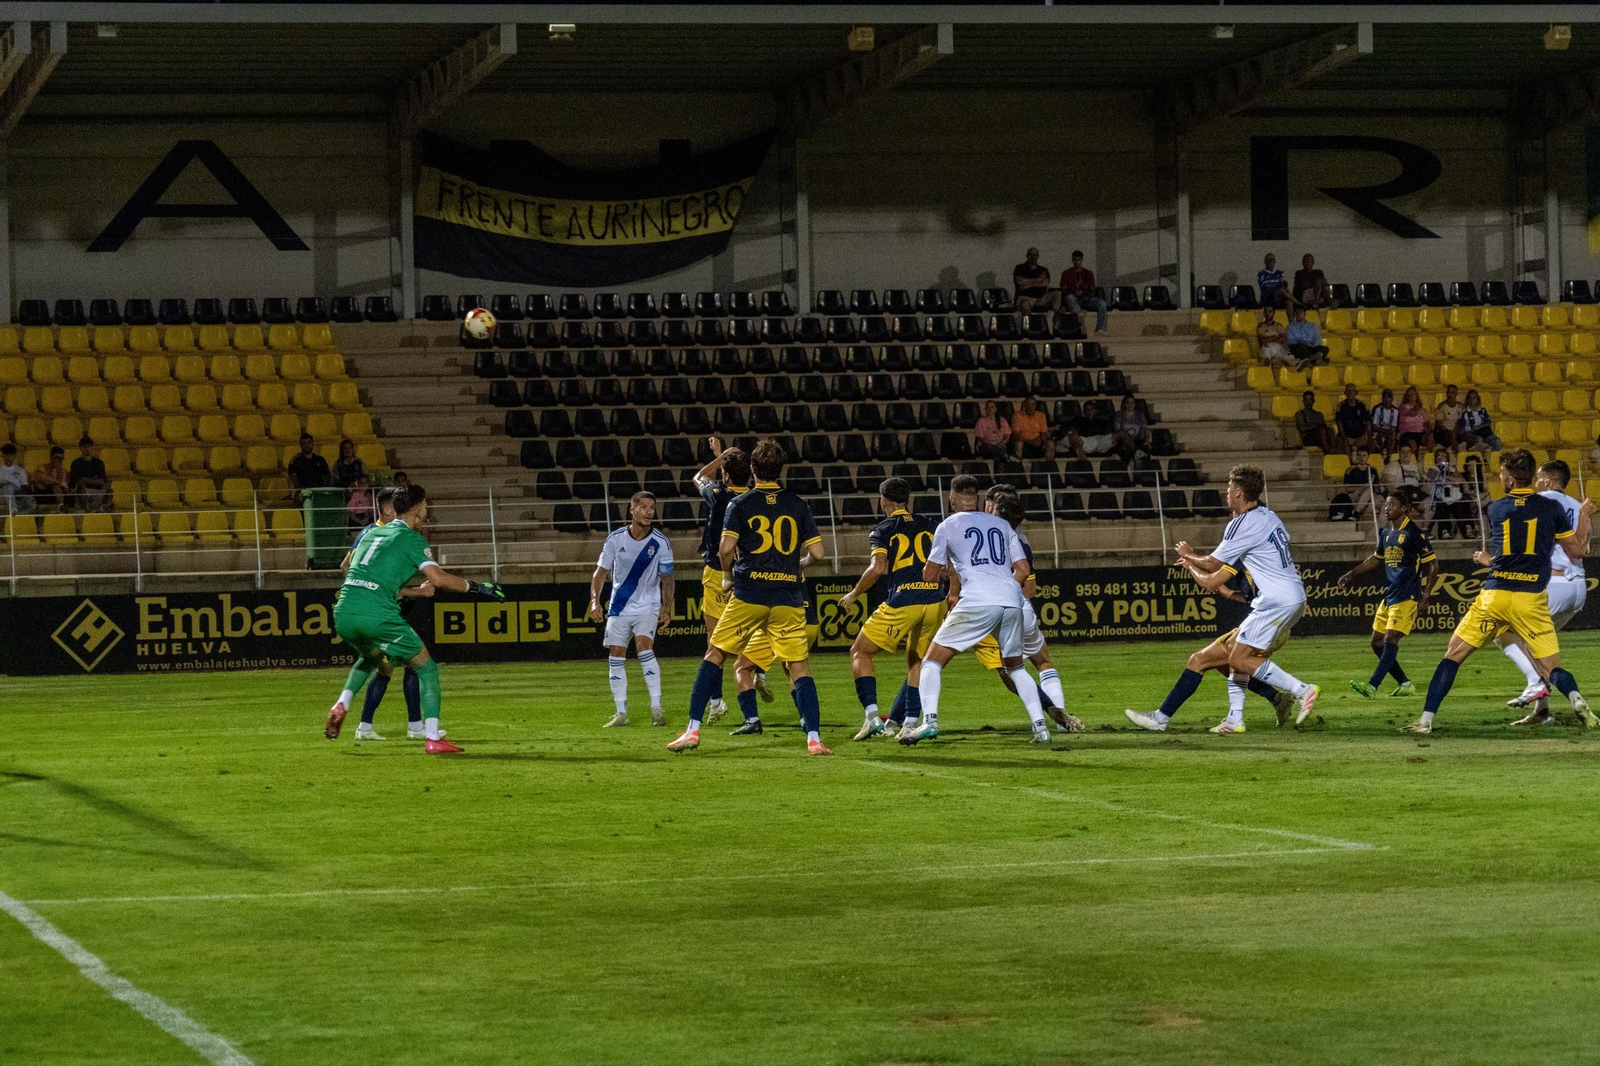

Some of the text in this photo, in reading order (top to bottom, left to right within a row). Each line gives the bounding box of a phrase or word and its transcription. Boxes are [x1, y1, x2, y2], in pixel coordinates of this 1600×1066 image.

[85, 139, 311, 252] A
[1251, 135, 1442, 240] R
[437, 179, 557, 236] FRENTE
[747, 514, 798, 556] 30
[964, 527, 1006, 567] 20
[1500, 517, 1539, 556] 11
[358, 536, 384, 566] 1
[889, 530, 935, 573] 20
[815, 583, 854, 594] Cadena
[1075, 583, 1101, 597] 959
[1104, 582, 1128, 596] 481
[1132, 581, 1156, 595] 331
[1162, 583, 1177, 596] LA
[1037, 597, 1218, 627] OS Y POLLAS
[1302, 603, 1361, 618] Avenida
[1437, 616, 1456, 630] 56
[1061, 622, 1218, 639] www.polloasadolaantilla.com
[136, 641, 231, 656] HUELVA
[136, 657, 317, 672] www.embalajeshuelva.com
[331, 655, 354, 666] 959
